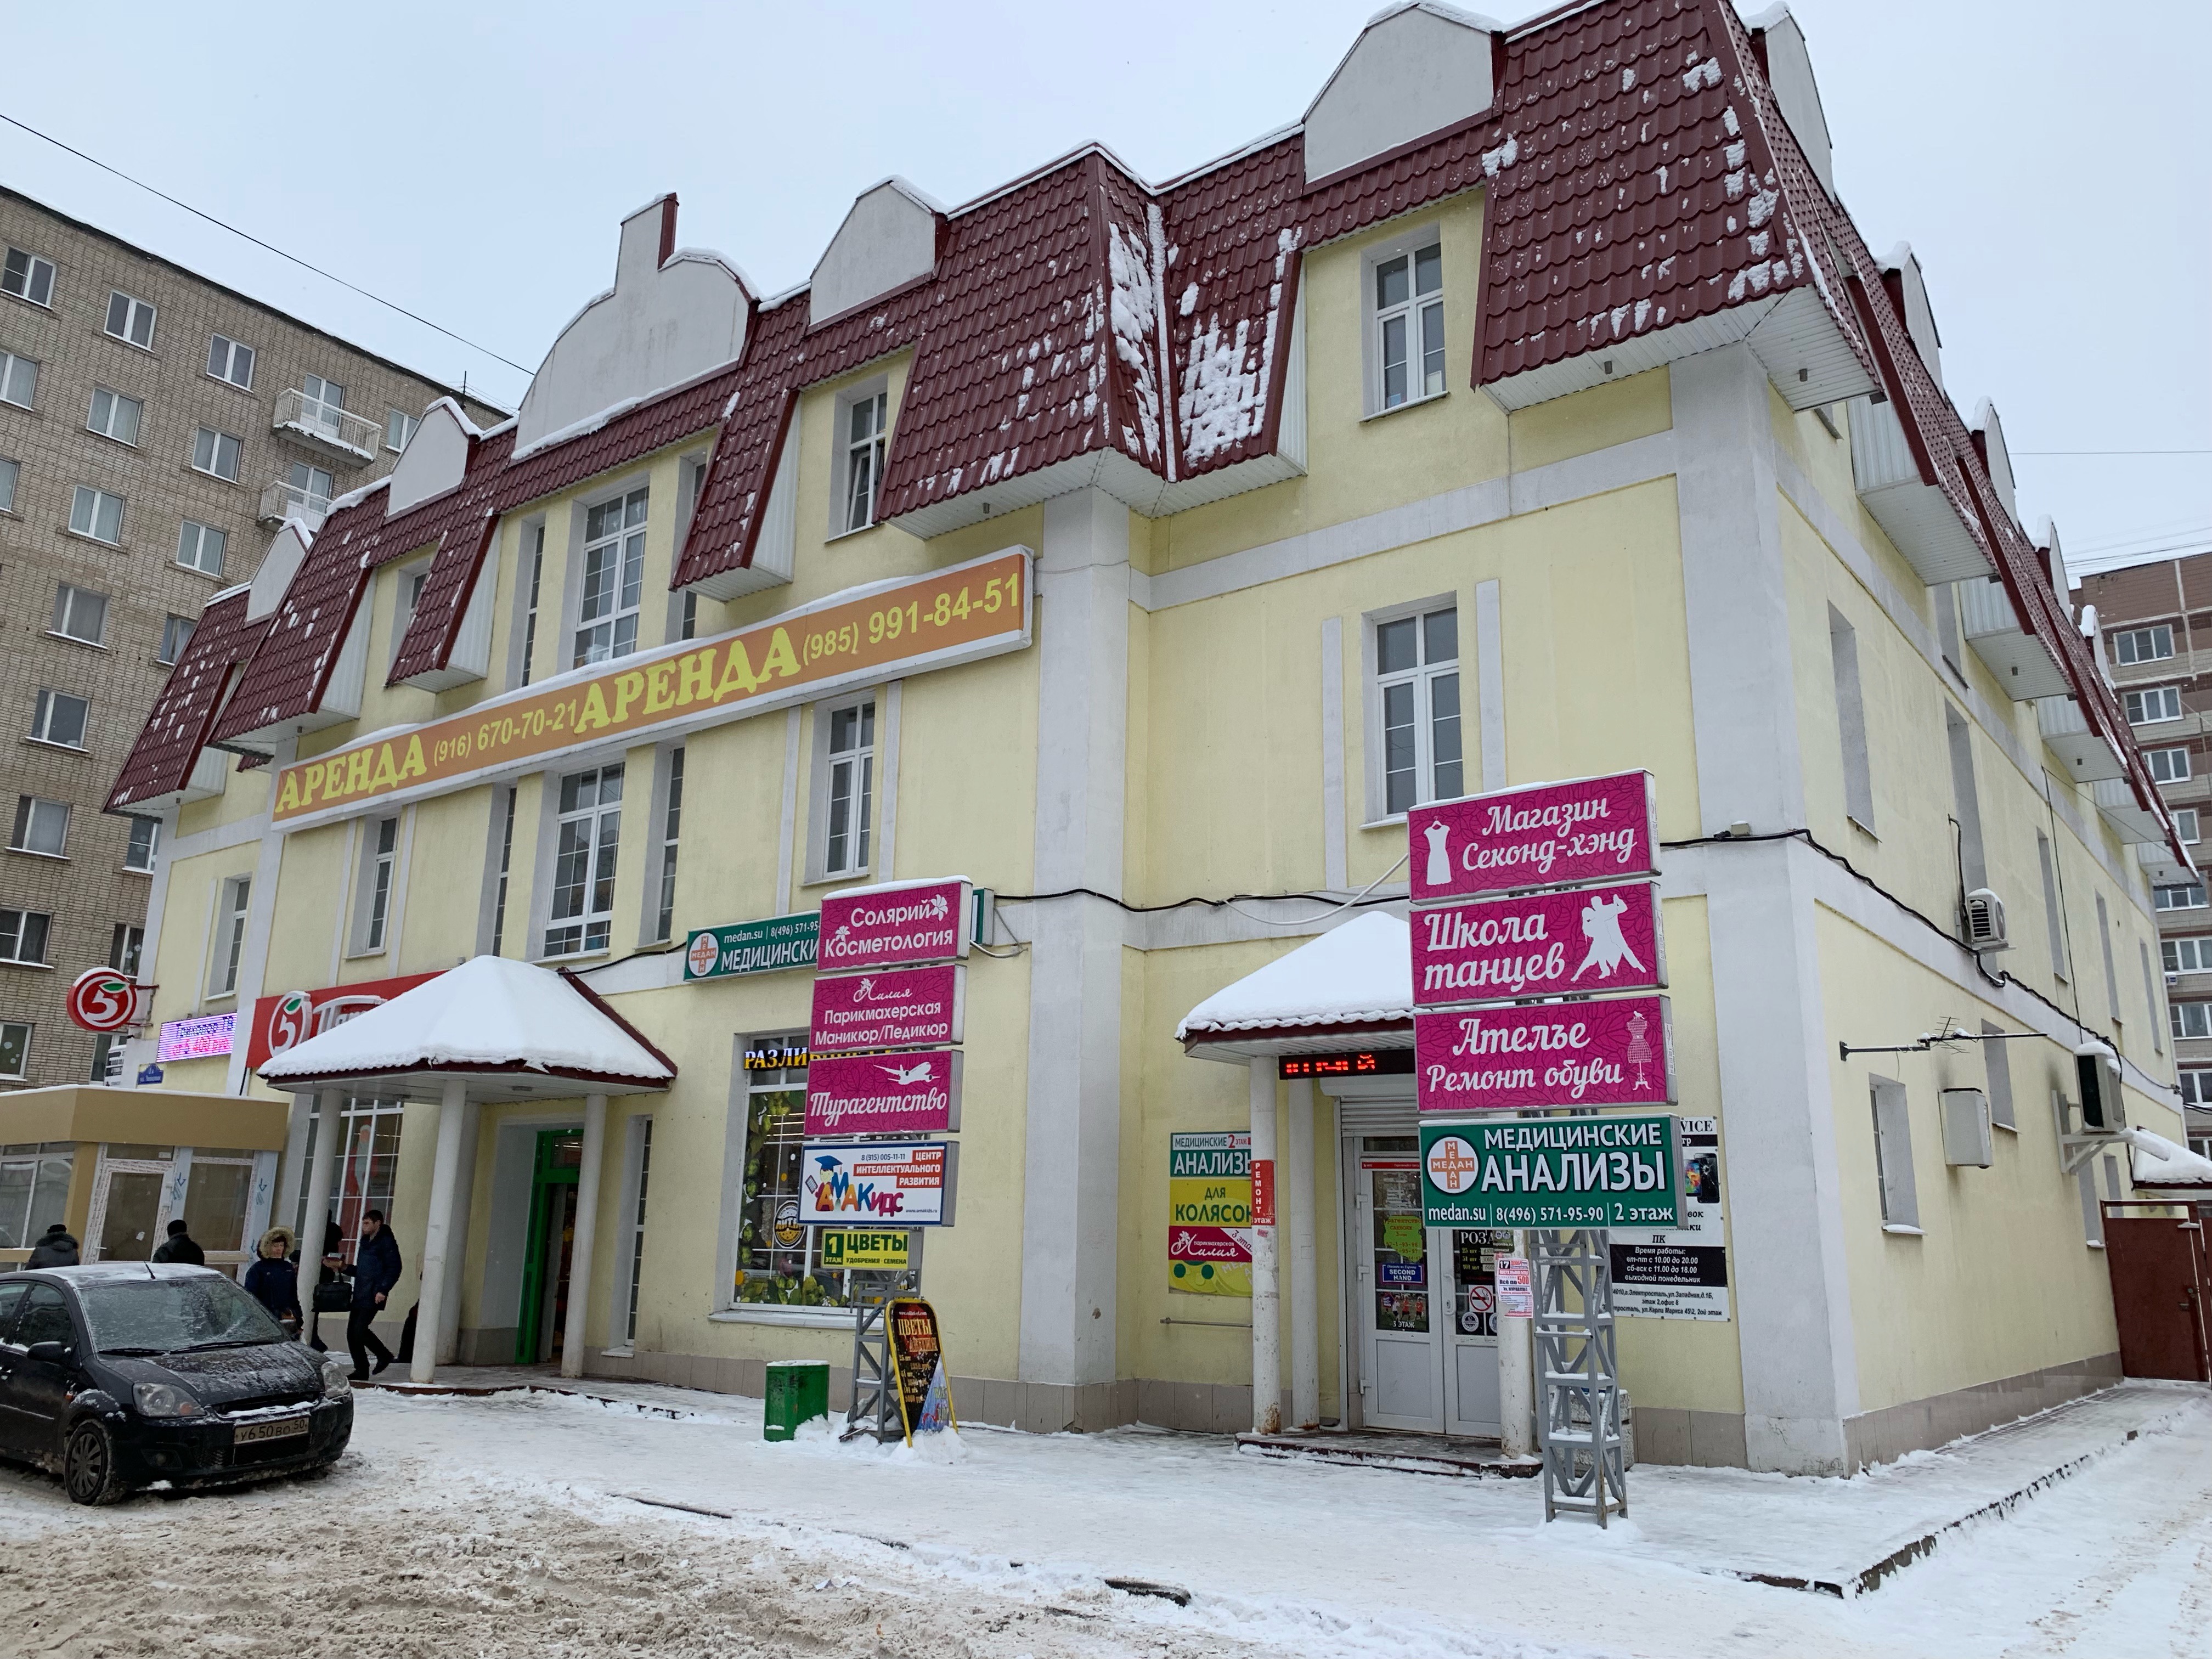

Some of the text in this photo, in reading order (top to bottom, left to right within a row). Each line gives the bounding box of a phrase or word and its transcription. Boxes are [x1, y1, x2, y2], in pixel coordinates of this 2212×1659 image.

[573, 573, 1018, 734] АРЕНДА (985) 991-84-51
[275, 699, 577, 813] АРЕНДА (916) 670-70-21
[1481, 797, 1611, 838] Магазин
[1462, 828, 1638, 873] Секонд-хэнд
[850, 899, 932, 927] Солярий
[724, 921, 821, 944] medan.su 8(496) 571-95-
[1424, 911, 1548, 952] Школа
[721, 938, 819, 972] МЕДИЦИНСКИ
[825, 929, 953, 958] Косметология
[1424, 942, 1565, 992] танцев
[824, 1002, 941, 1025] Парикмахерская
[815, 1023, 948, 1047] Маникюр/Педикюр
[1453, 1018, 1590, 1056] Ателье
[744, 1047, 808, 1069] РАЗЛИ
[1427, 1058, 1624, 1099] Ремонт обуви
[810, 1087, 947, 1127] Турагентство
[1485, 1123, 1662, 1152] МЕДИЦИНСКИЕ
[1680, 1120, 1713, 1132] VICE
[1175, 1137, 1227, 1149] МЕДИЦИНСКИЕ
[1228, 1135, 1235, 1149] 2
[866, 1153, 879, 1161] (915)
[916, 1152, 941, 1161] ЦЕНТР
[1432, 1160, 1473, 1169] МЕДАН
[856, 1164, 940, 1174] ИНТЕЛЛЕКТУАЛЬНОГО
[1481, 1151, 1666, 1192] АНАЛИЗЫ
[899, 1177, 940, 1186] РАЗВИТИЯ
[1205, 1187, 1226, 1200] ДЛЯ
[1428, 1203, 1486, 1221] medan.su
[1496, 1206, 1536, 1224] 8(496)
[1541, 1207, 1604, 1221] 571-95-90
[1615, 1203, 1624, 1220] 2
[1629, 1207, 1674, 1221] этаж
[828, 1233, 908, 1254] 1 ЦВЕТЫ
[1232, 1229, 1252, 1252] 3 эта
[1652, 1234, 1666, 1243] ПК
[1635, 1246, 1686, 1256] Время работы:
[1500, 1261, 1510, 1269] 17
[1517, 1276, 1529, 1284] 500
[898, 1318, 933, 1335] ЦВЕТЫ
[294, 1419, 305, 1430] 50
